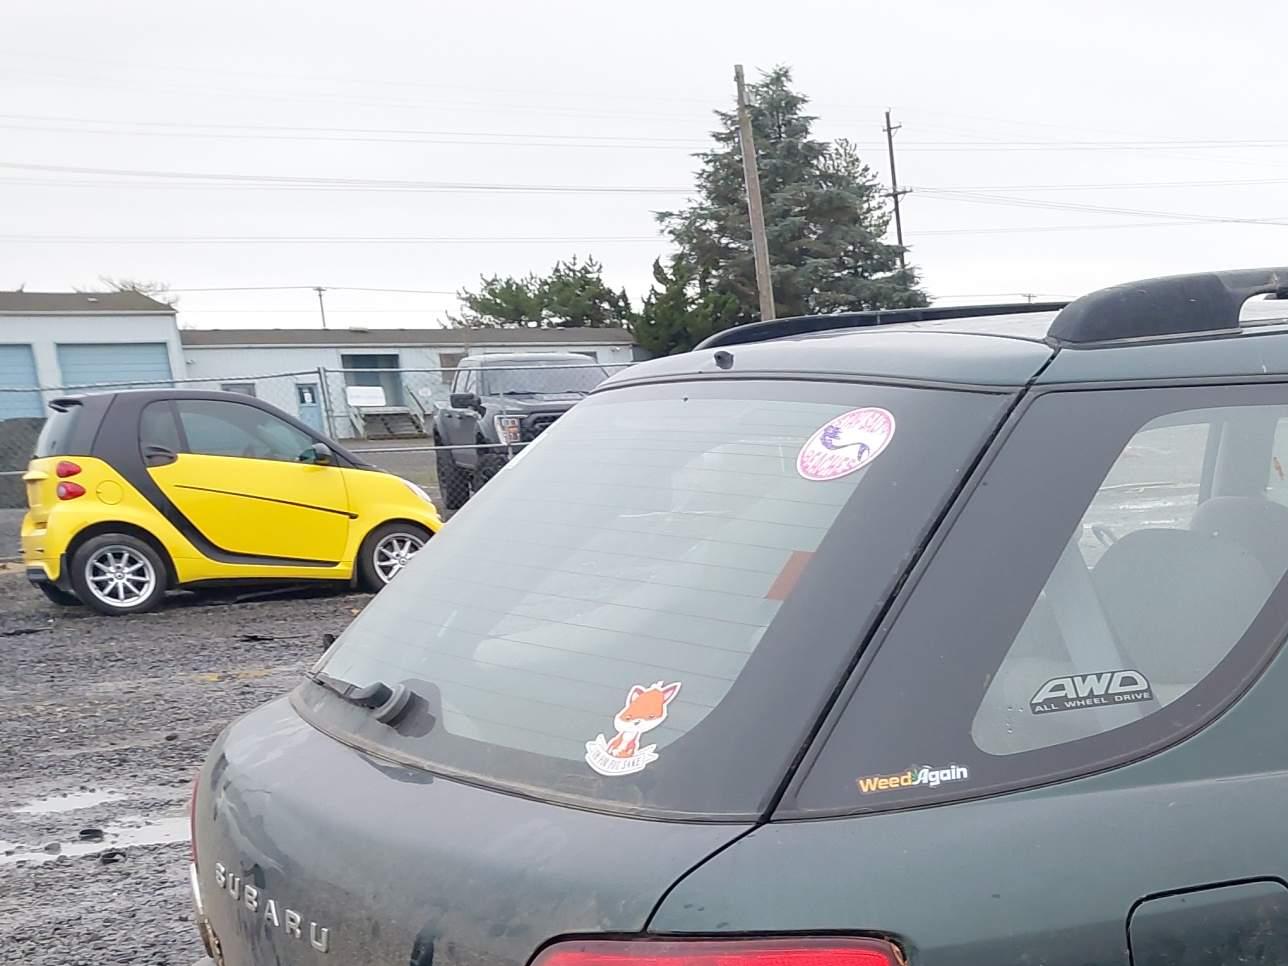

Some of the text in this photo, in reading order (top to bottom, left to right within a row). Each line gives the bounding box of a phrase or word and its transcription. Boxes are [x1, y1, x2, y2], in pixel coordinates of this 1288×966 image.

[1031, 669, 1150, 703] AWD
[1034, 691, 1151, 713] ALL WHEEL DRIVE
[215, 862, 330, 954] SUBARU
